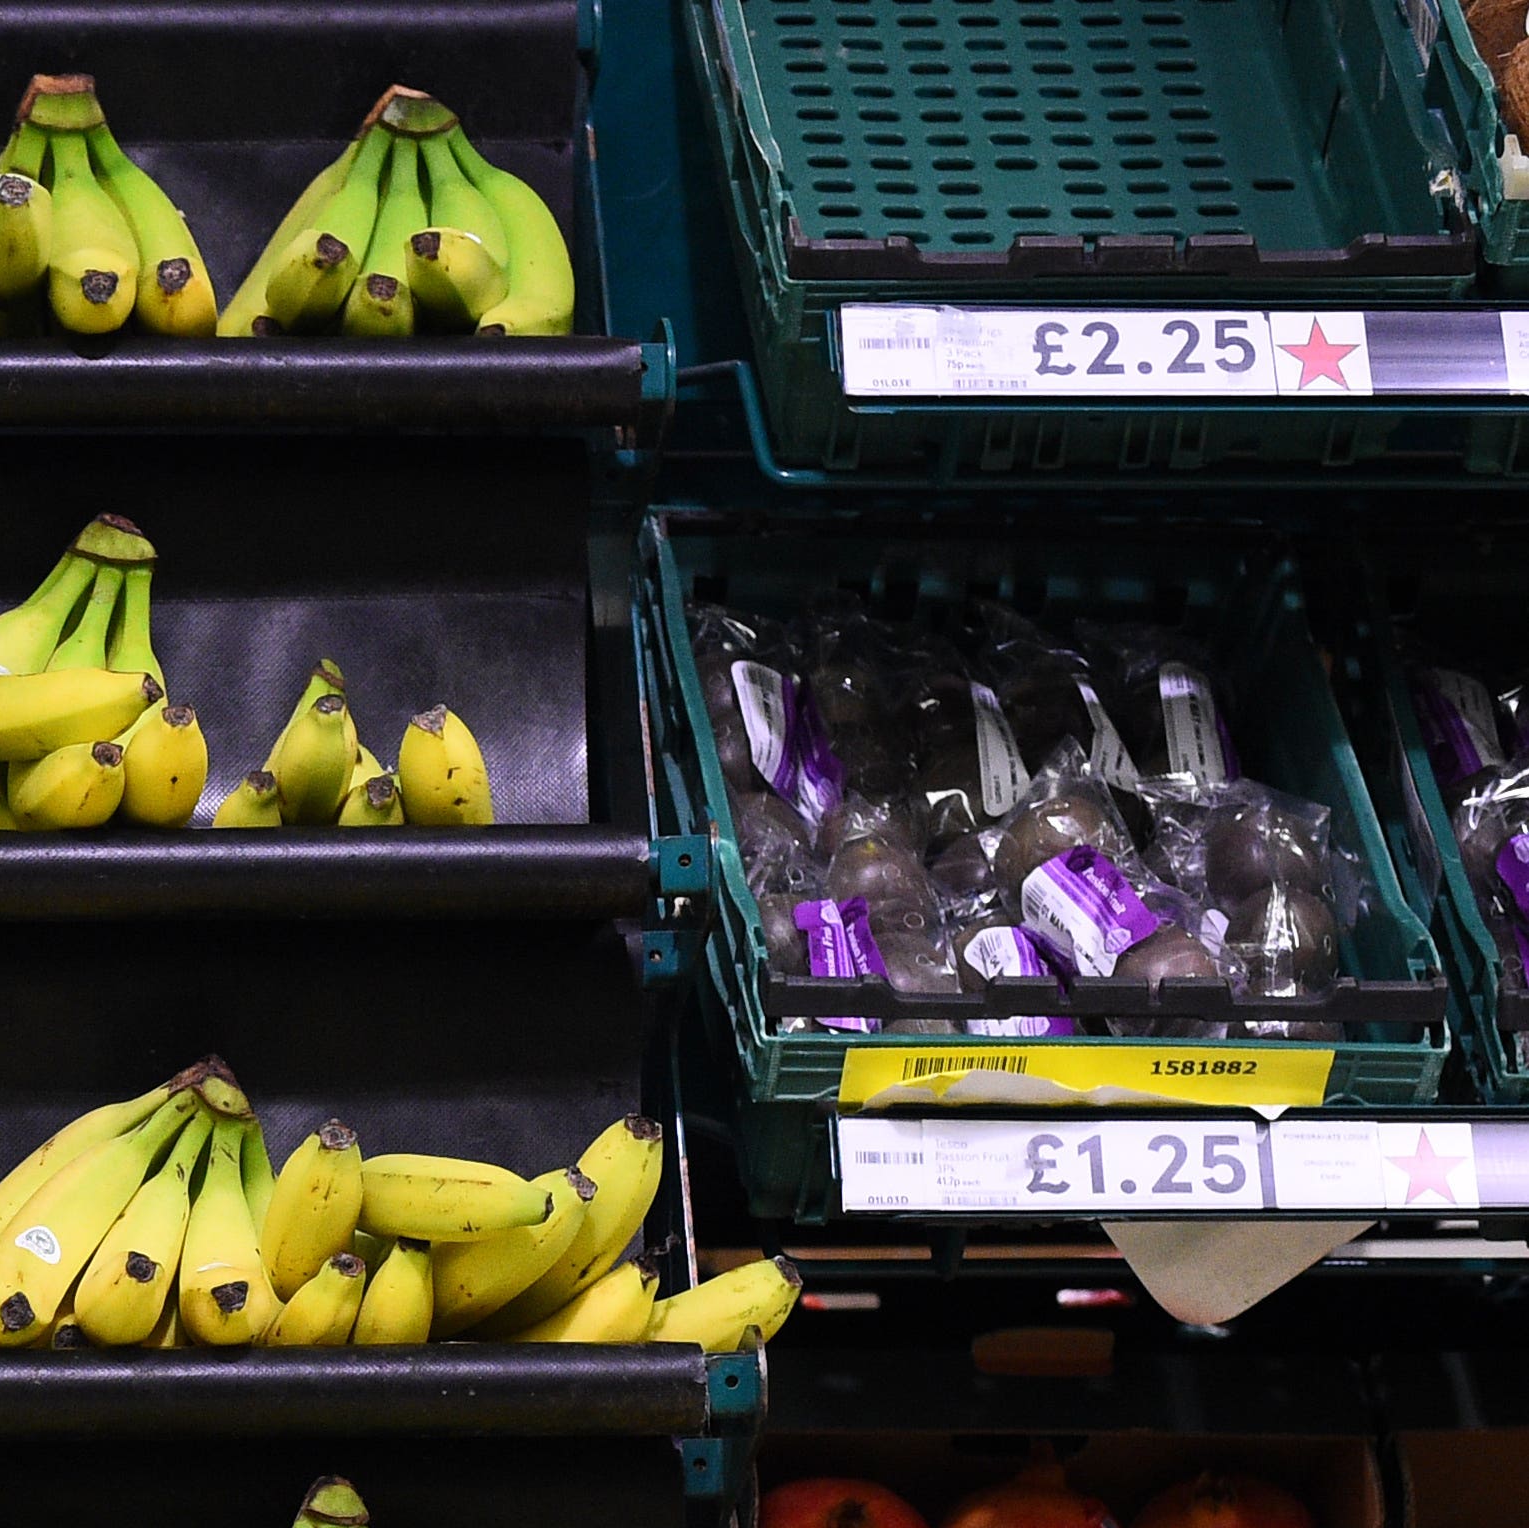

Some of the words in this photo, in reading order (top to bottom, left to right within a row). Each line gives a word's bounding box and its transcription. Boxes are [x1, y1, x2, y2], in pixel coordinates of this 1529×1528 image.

[1032, 319, 1256, 376] £2.25
[1082, 865, 1111, 899] Passion
[1106, 893, 1127, 917] Fruit
[1150, 1060, 1258, 1075] 1581882
[1025, 1134, 1247, 1194] £1.25
